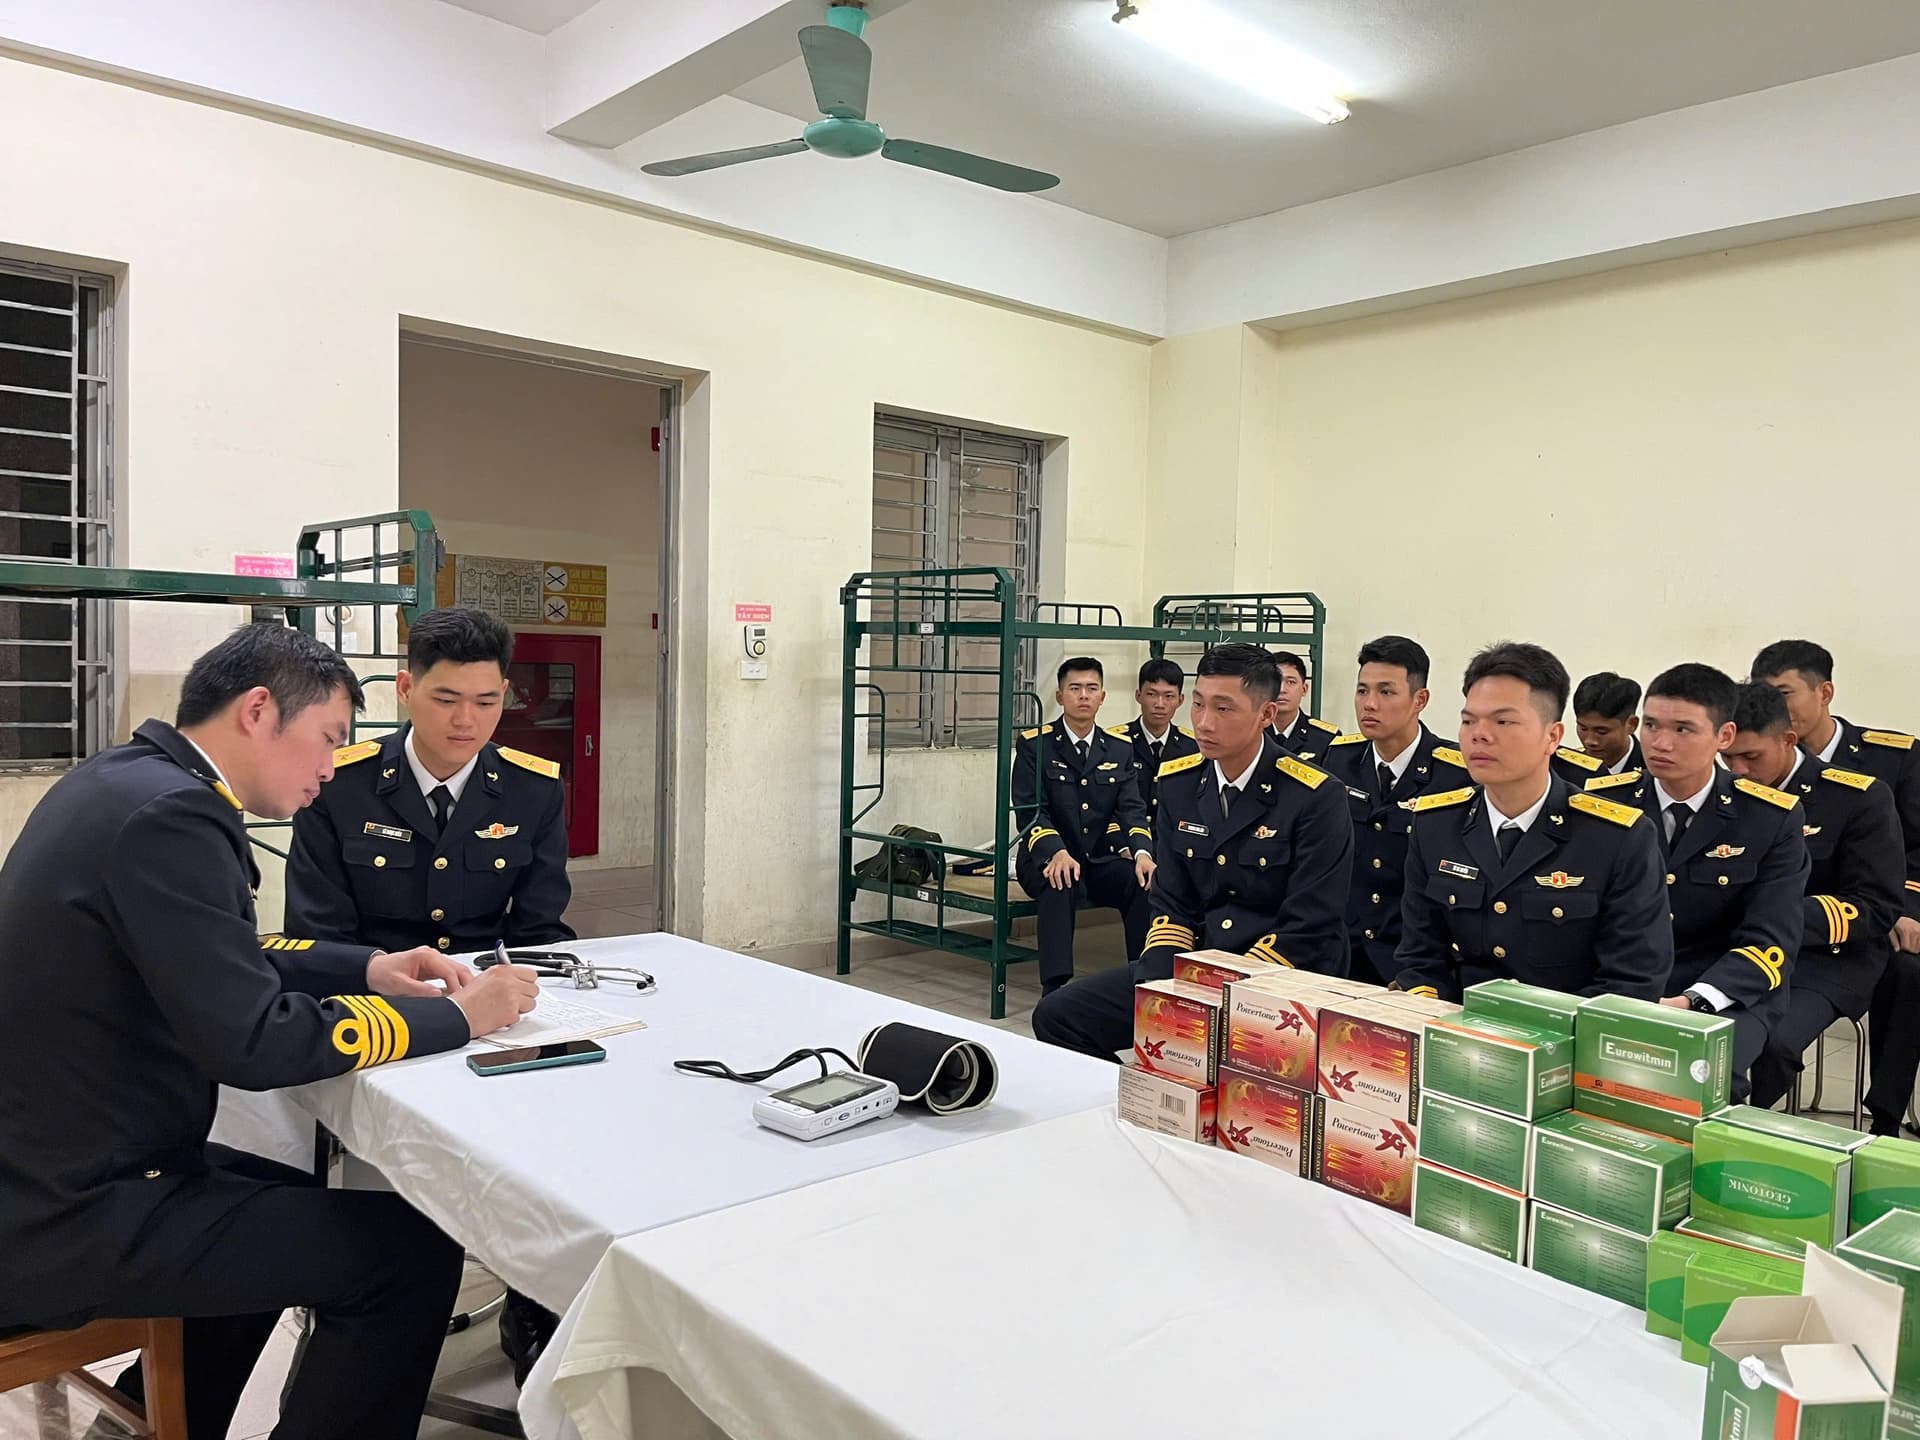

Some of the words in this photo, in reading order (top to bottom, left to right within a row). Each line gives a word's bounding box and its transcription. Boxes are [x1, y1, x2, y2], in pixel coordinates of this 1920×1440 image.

[1236, 1002, 1276, 1021] Powertona
[1605, 1041, 1672, 1069] Eurowitmin
[1331, 1117, 1377, 1140] Powertona
[1728, 1178, 1792, 1204] GEOTONIK
